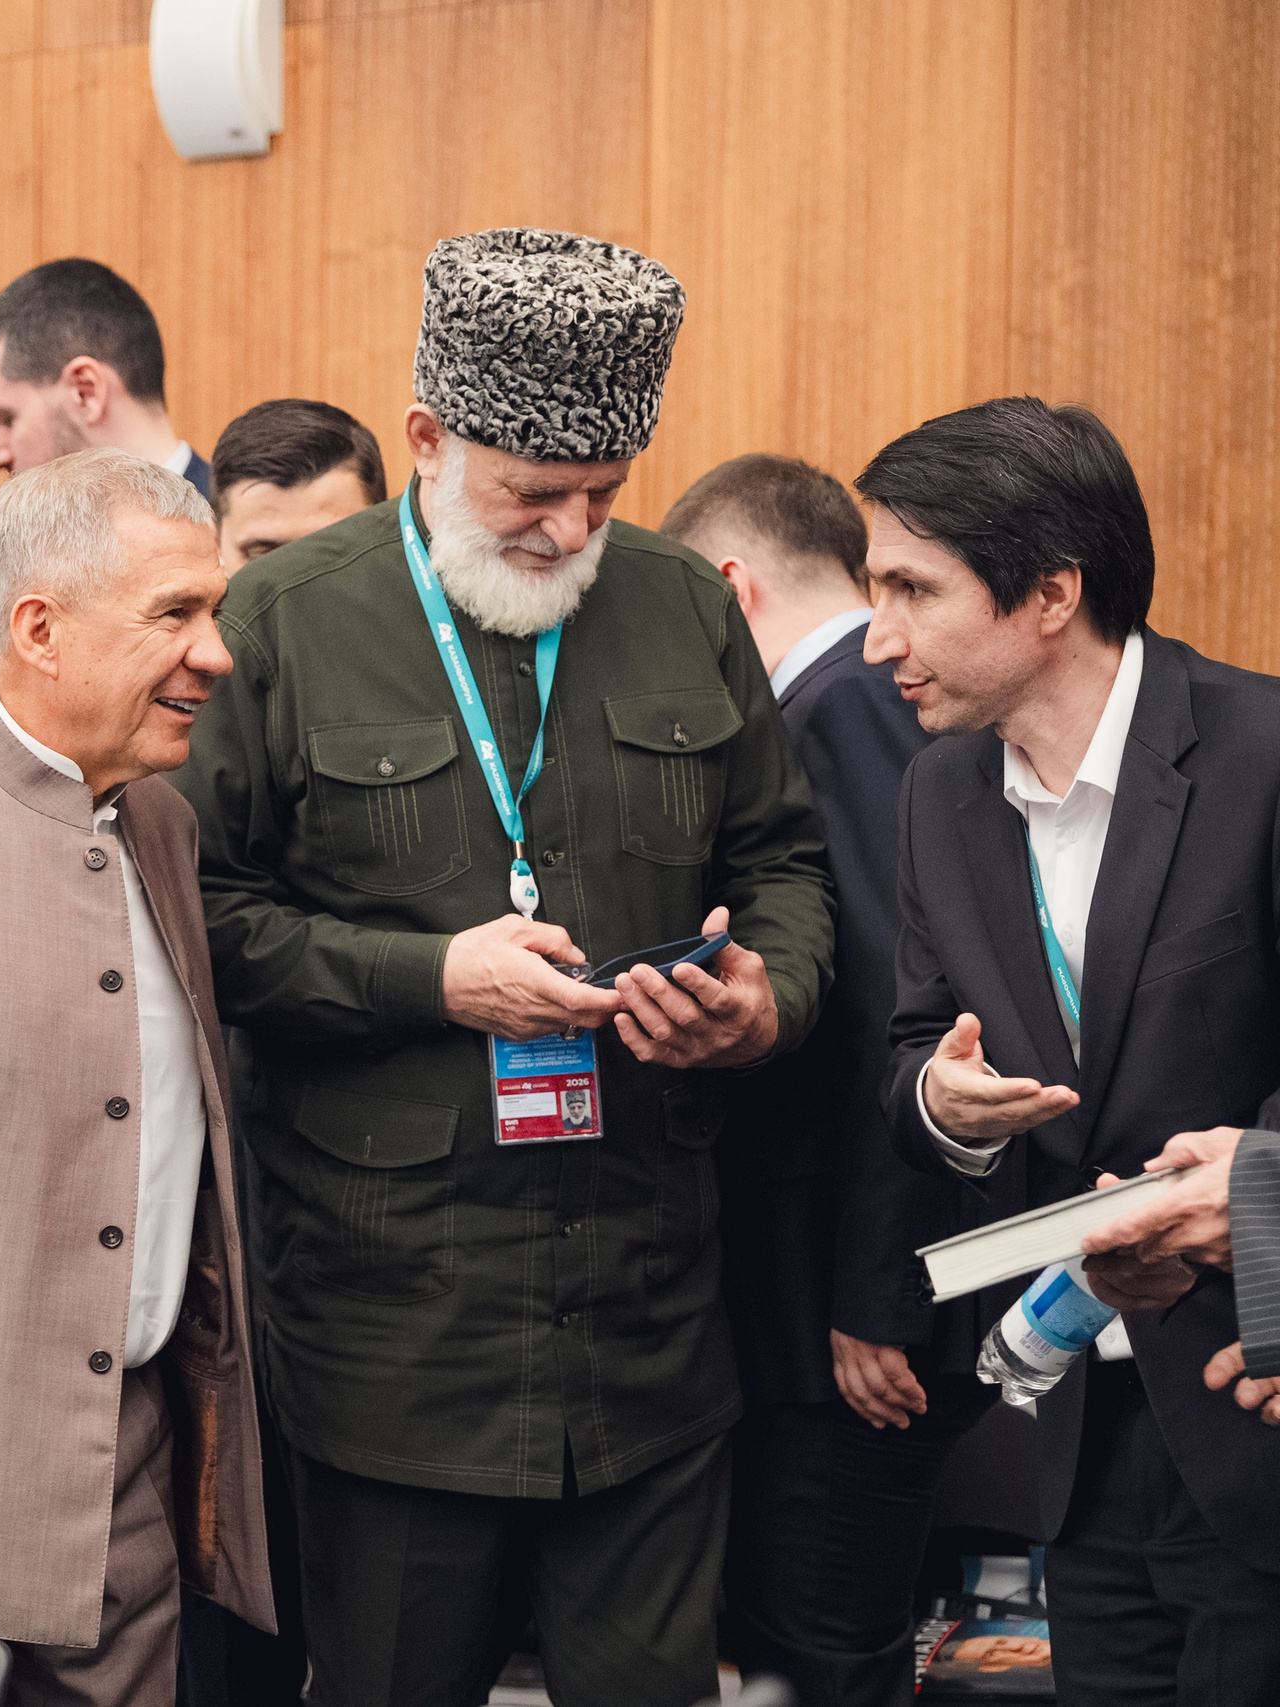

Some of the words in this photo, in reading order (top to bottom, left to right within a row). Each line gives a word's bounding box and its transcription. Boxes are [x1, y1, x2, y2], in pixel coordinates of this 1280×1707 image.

[411, 543, 432, 590] KAZANFORUM
[447, 644, 473, 705] КАЗАНЬФОРУМ
[489, 762, 512, 816] KAZANFORUM
[1057, 966, 1080, 1020] ЗАНЬФОРУМ
[566, 1078, 589, 1087] 2026
